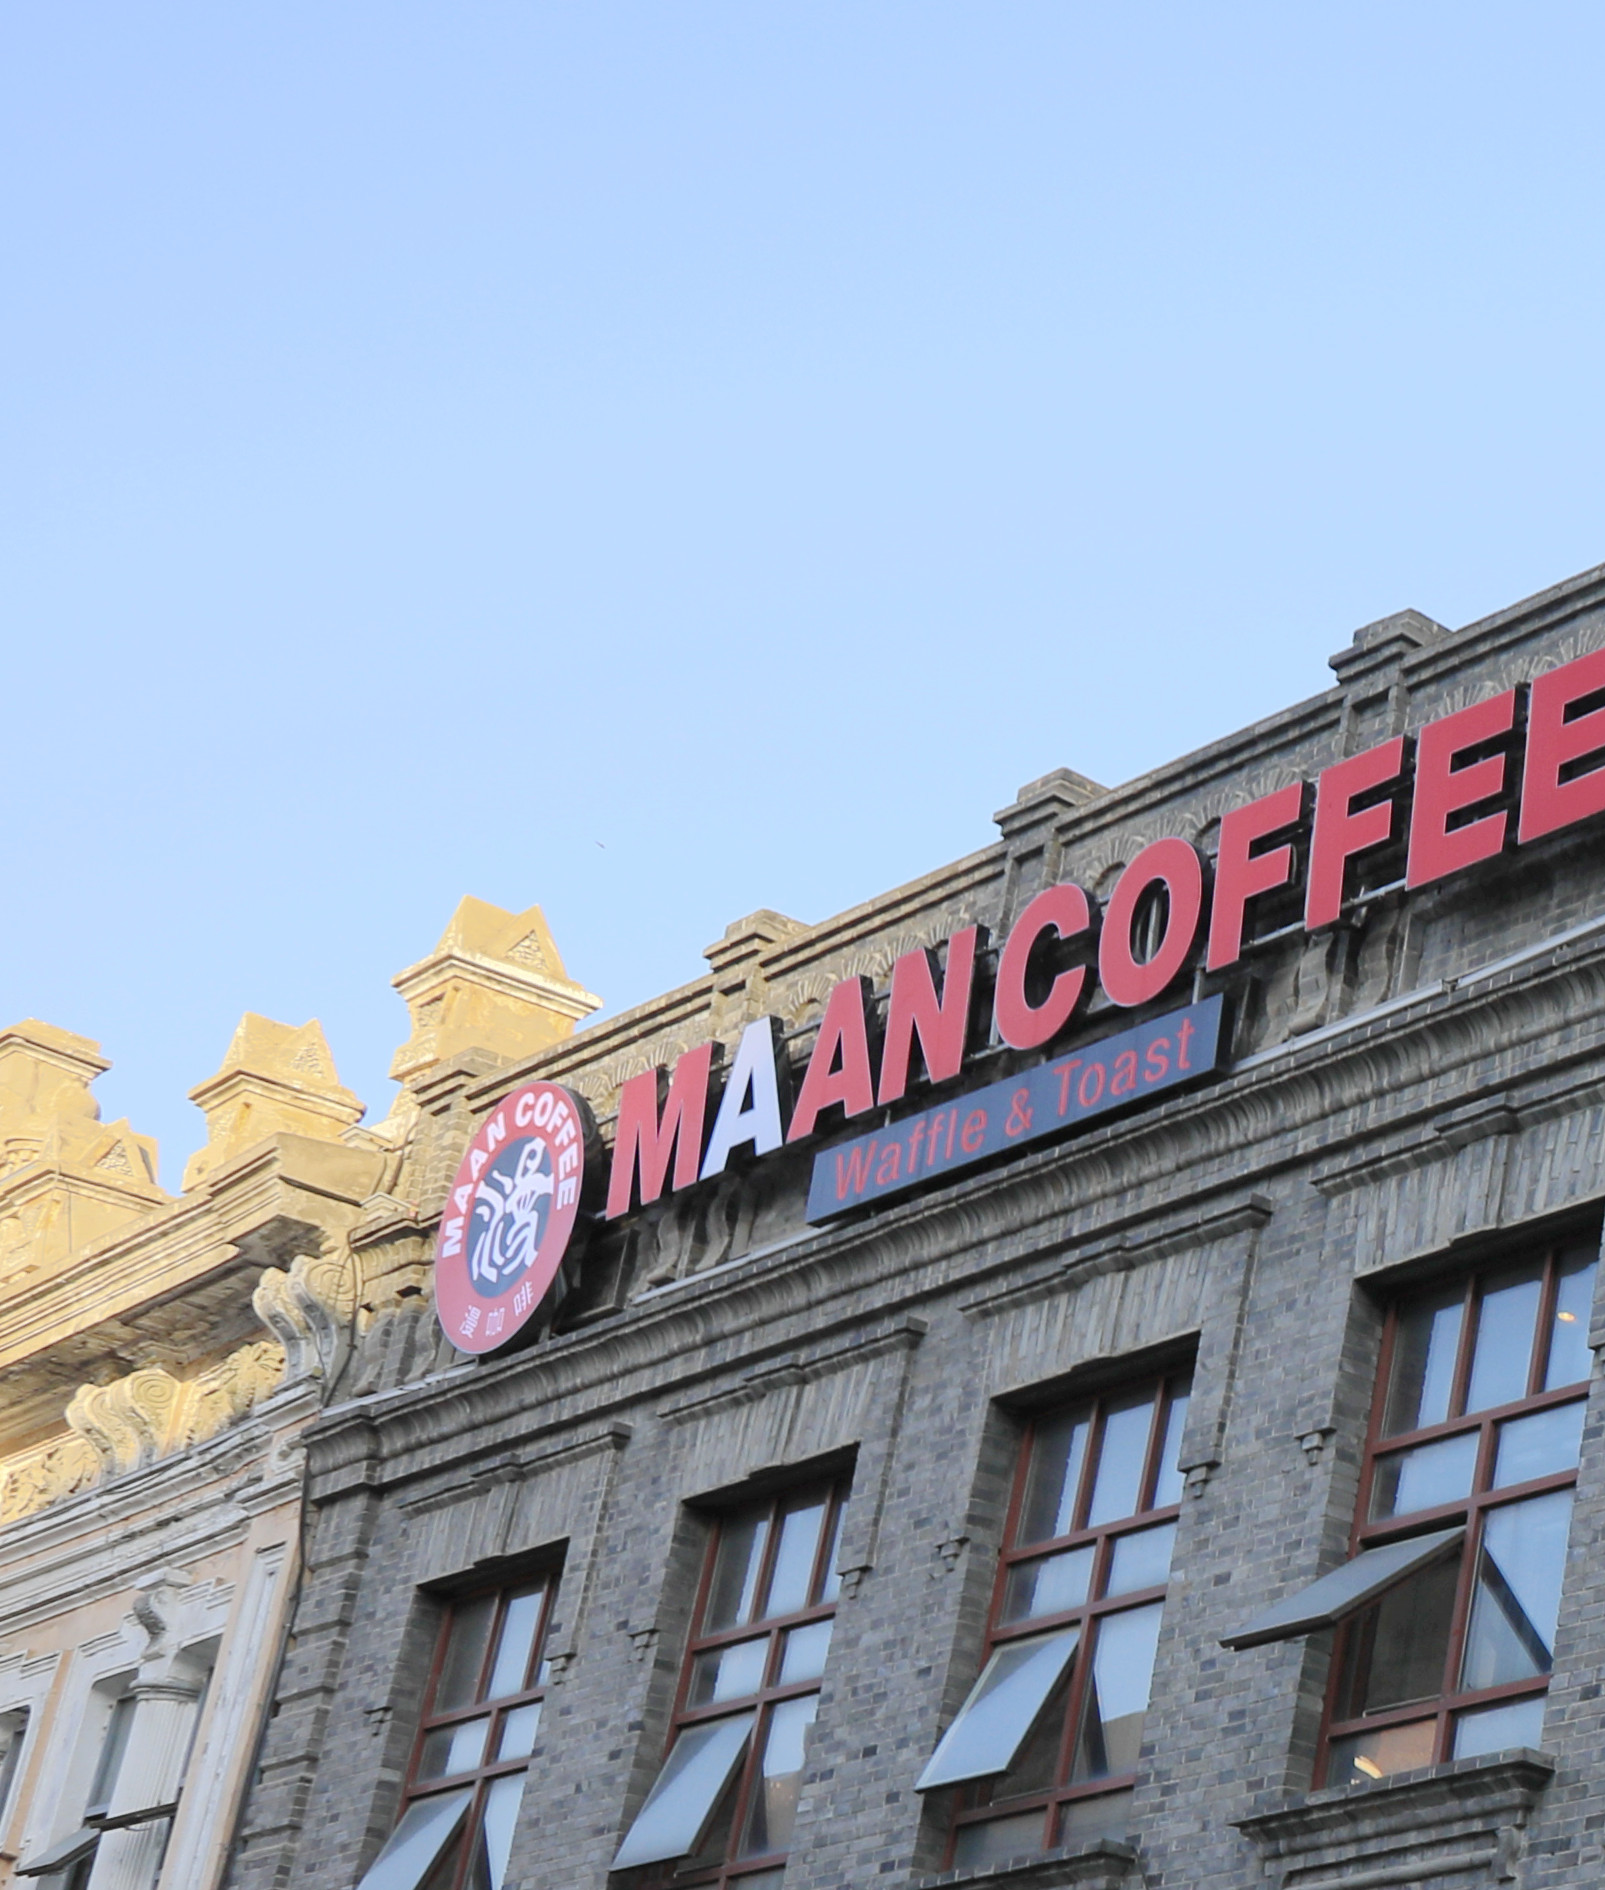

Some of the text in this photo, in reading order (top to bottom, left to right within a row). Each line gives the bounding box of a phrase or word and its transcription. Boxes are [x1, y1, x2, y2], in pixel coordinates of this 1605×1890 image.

[606, 925, 988, 1221] MAAN
[835, 1018, 1196, 1200] Waffle & Toast
[441, 1091, 579, 1259] MAAN COFFEE
